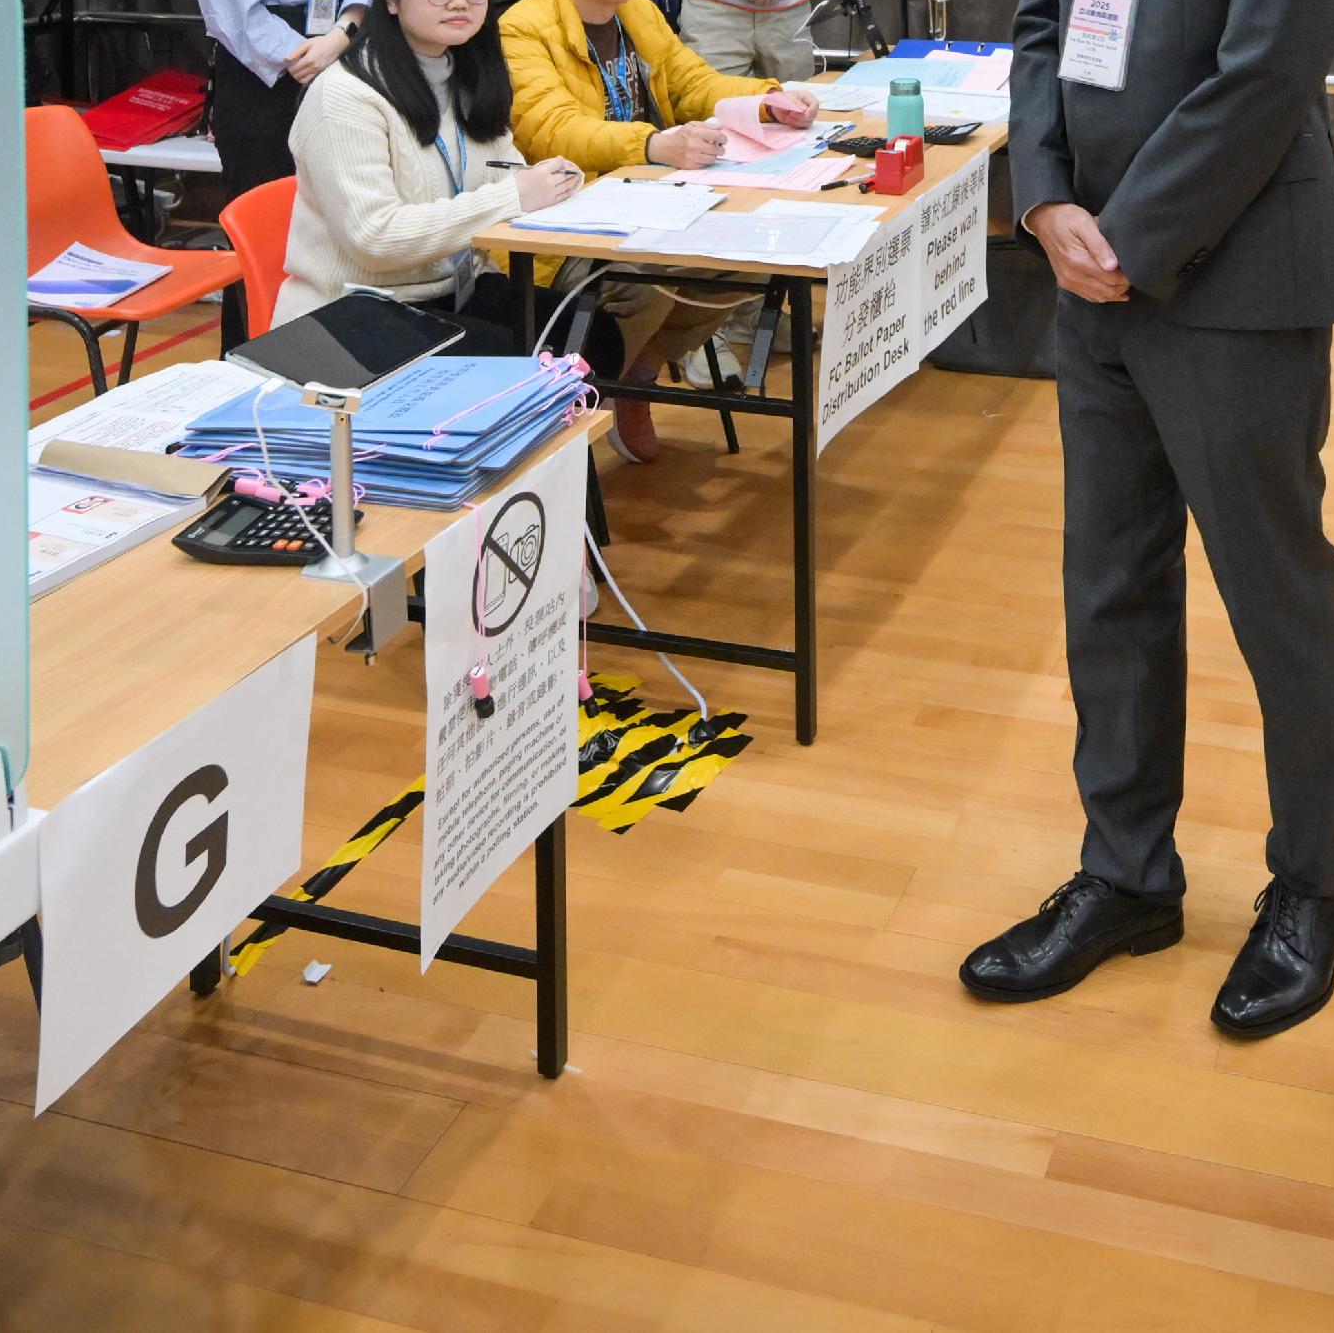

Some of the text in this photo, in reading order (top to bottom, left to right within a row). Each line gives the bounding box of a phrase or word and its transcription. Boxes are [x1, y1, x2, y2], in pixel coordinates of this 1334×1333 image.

[1090, 0, 1111, 10] 2025
[834, 225, 915, 311] 功能界別選票
[926, 206, 979, 265] Please wait
[933, 246, 966, 292] behind
[923, 276, 975, 337] the red line
[822, 337, 910, 426] Distribution Desk
[828, 313, 906, 391] FC Ballot Paper
[434, 851, 444, 871] any
[447, 829, 465, 853] other
[467, 803, 488, 830] device
[491, 787, 500, 804] for
[559, 724, 566, 738] or
[437, 816, 459, 847] mobile
[499, 753, 521, 780] paging
[524, 724, 553, 755] machine
[555, 713, 562, 726] or
[438, 802, 459, 829] Except
[462, 785, 471, 803] for
[473, 749, 509, 789] authorized
[543, 705, 555, 722] use
[557, 693, 564, 708] of
[135, 764, 228, 939] G
[432, 886, 444, 906] any
[446, 839, 486, 888] audio/video
[487, 803, 520, 841] recording
[531, 756, 566, 797] prohibited
[434, 859, 454, 886] taking
[531, 766, 538, 781] or
[540, 744, 565, 773] making
[459, 862, 479, 890] within
[487, 829, 510, 858] polling
